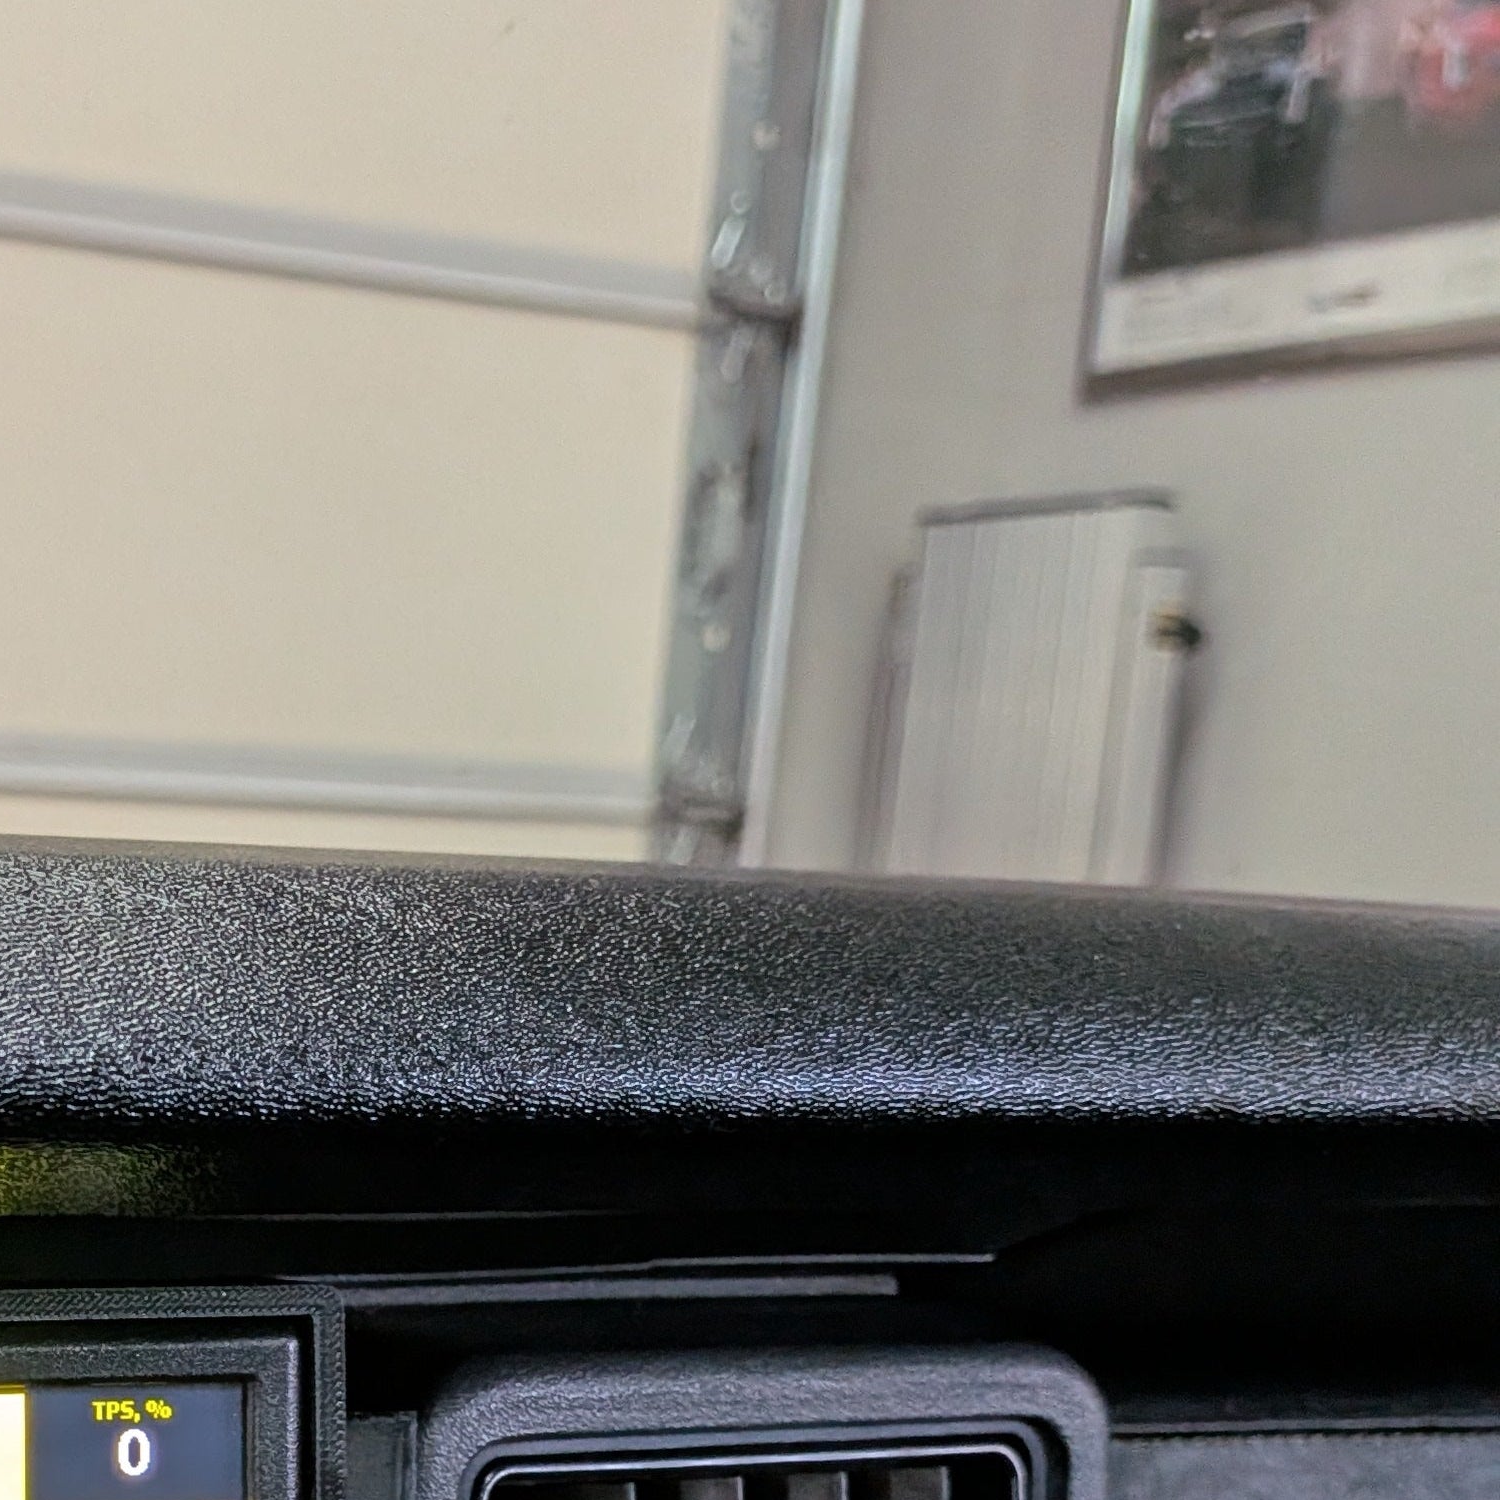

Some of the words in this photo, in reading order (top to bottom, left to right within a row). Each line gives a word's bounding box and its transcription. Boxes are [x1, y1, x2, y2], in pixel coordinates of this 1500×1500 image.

[92, 1401, 141, 1422] TPS,
[145, 1400, 172, 1420] %
[117, 1428, 152, 1477] 0
